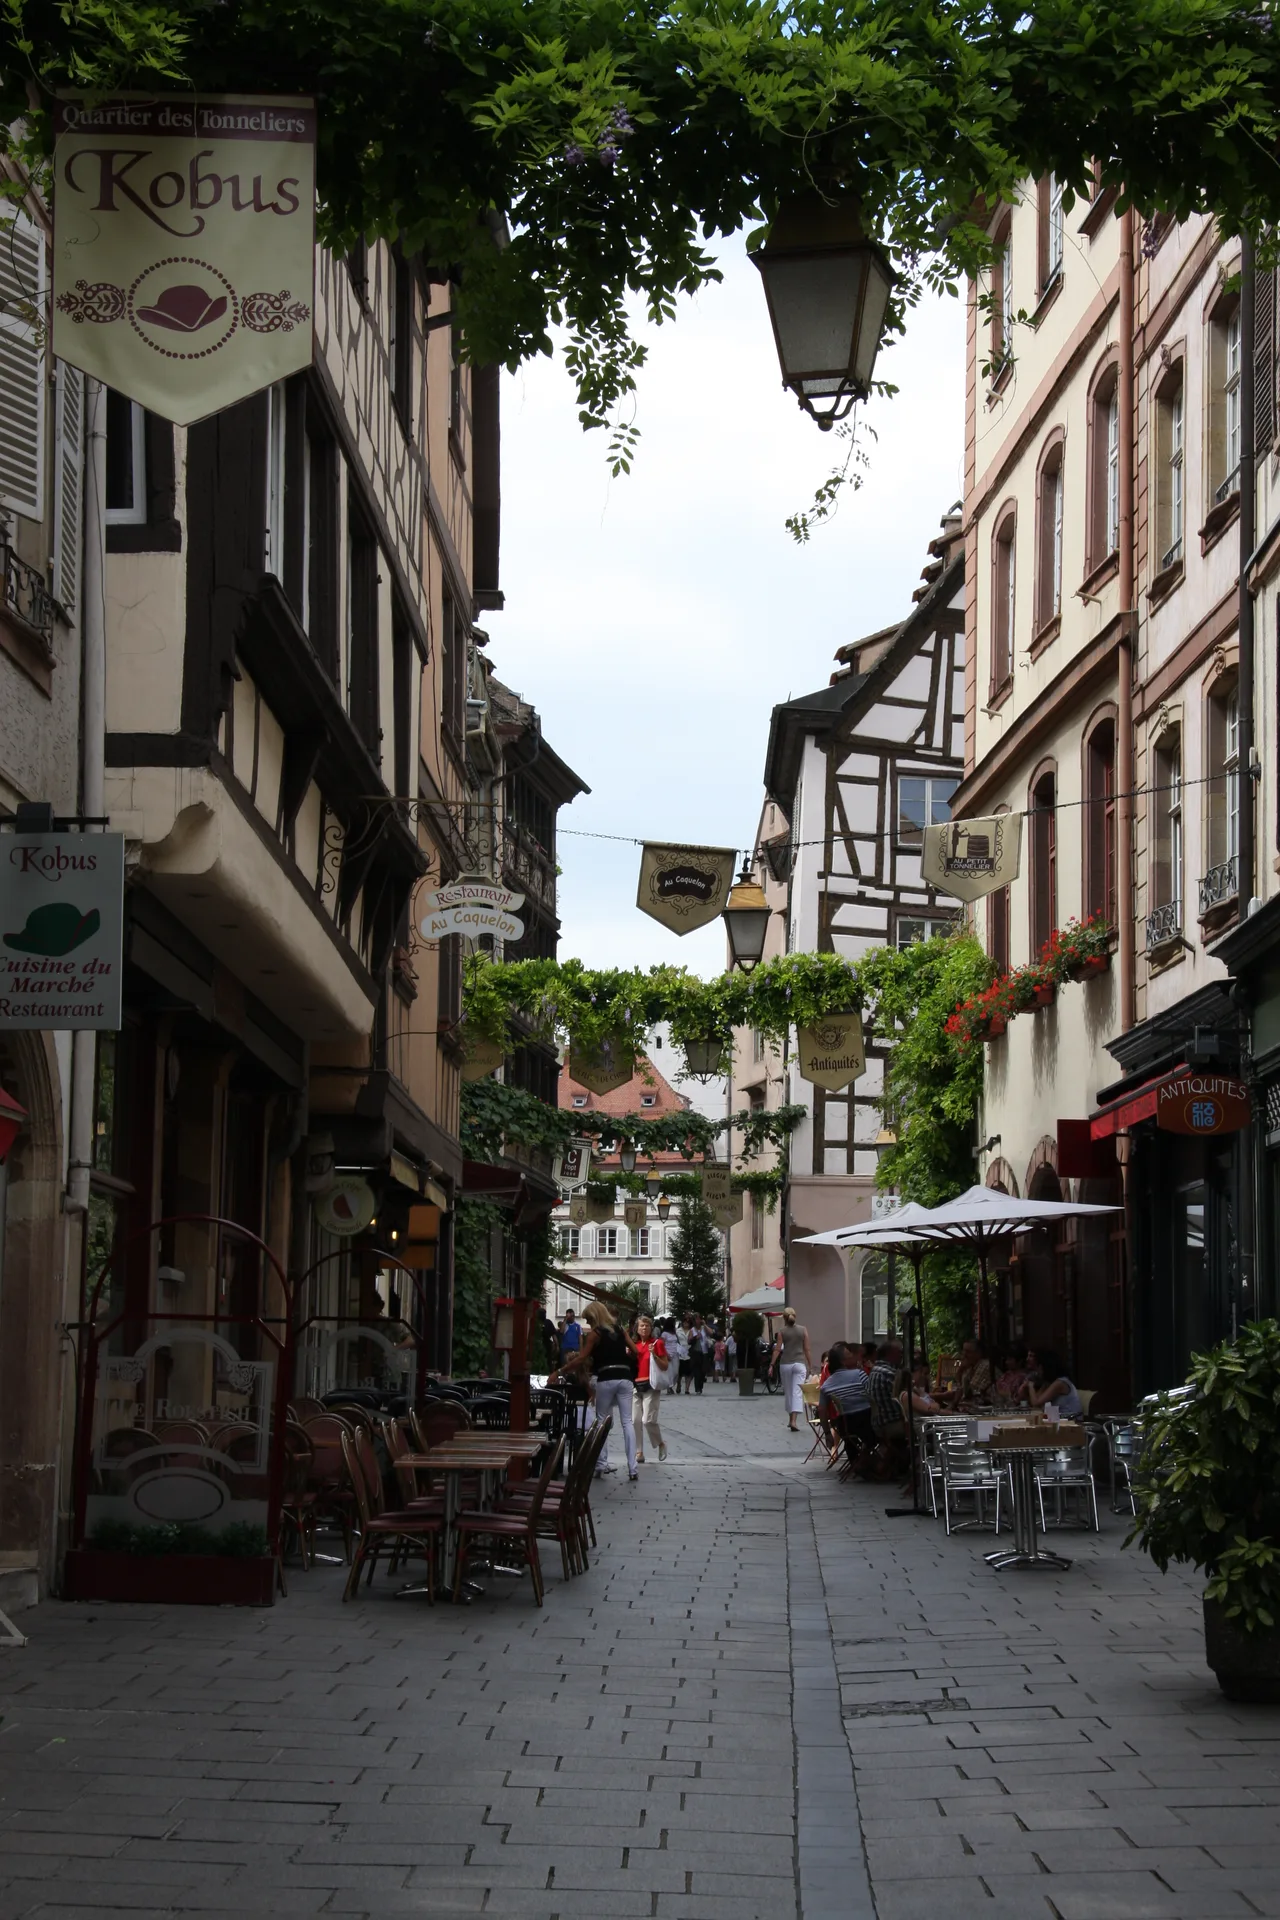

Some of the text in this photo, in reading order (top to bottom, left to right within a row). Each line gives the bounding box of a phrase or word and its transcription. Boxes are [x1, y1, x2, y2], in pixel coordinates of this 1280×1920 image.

[62, 106, 306, 134] Quartier des Tonneliers
[64, 149, 301, 238] Kobus
[9, 846, 97, 882] Kobus
[664, 875, 706, 890] Au Caquelon
[434, 884, 515, 907] Restaurant
[430, 910, 518, 937] Au Caquelon
[82, 957, 112, 975] du
[8, 976, 95, 994] Marché
[0, 998, 105, 1018] Restaurant
[807, 1055, 860, 1073] Antiquités
[1159, 1077, 1247, 1105] ANTIQUITES
[567, 1149, 578, 1164] C
